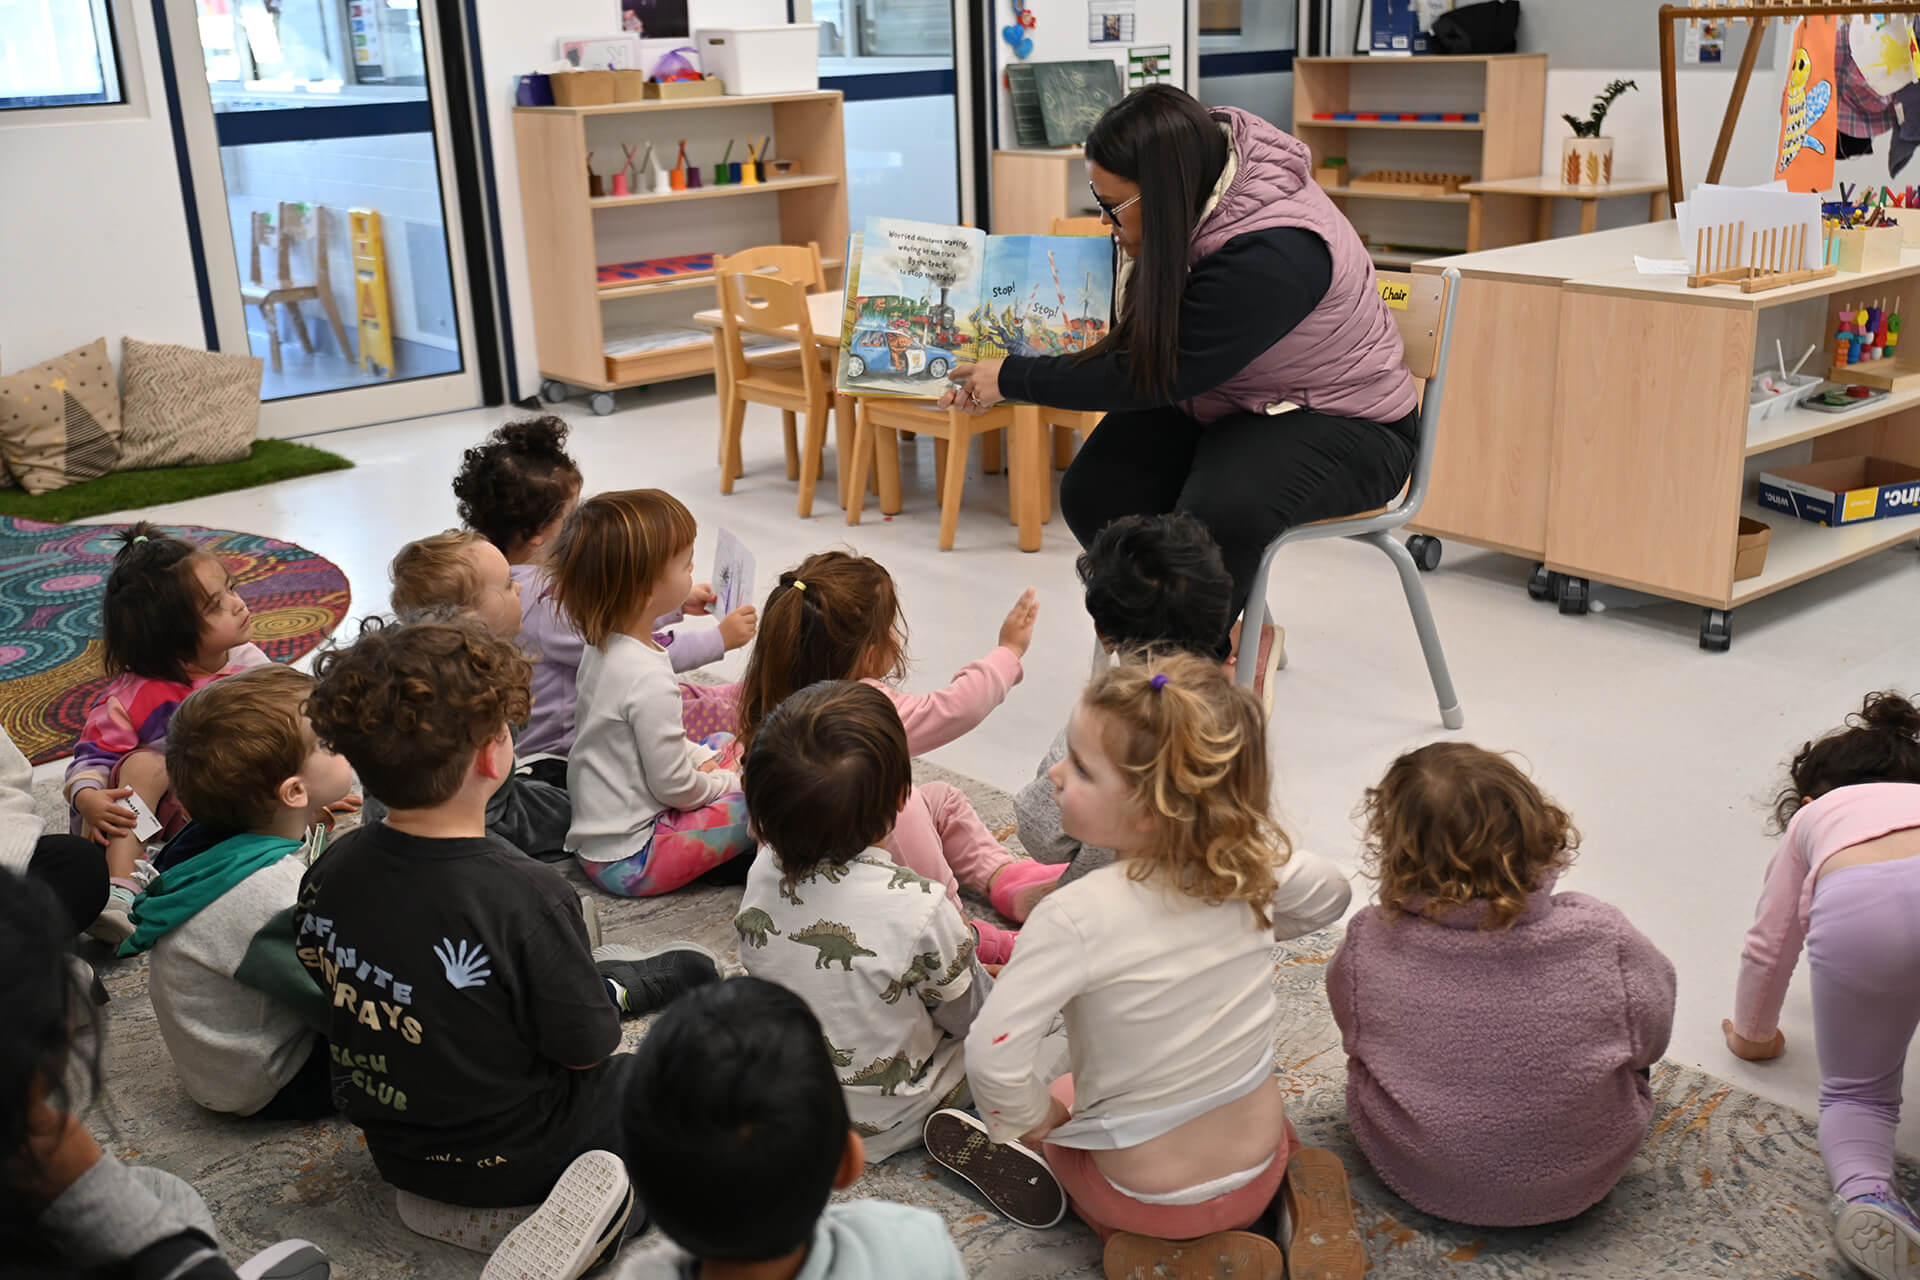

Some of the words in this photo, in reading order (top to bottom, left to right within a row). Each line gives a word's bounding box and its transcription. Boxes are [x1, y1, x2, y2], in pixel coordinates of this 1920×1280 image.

[888, 230, 916, 241] Worried
[898, 245, 922, 256] waving
[907, 269, 923, 279] stop
[992, 280, 1016, 298] Stop!
[1382, 286, 1407, 301] Chair
[1032, 302, 1060, 320] Stop!
[1884, 486, 1920, 507] inc.
[351, 1069, 408, 1111] CLUB
